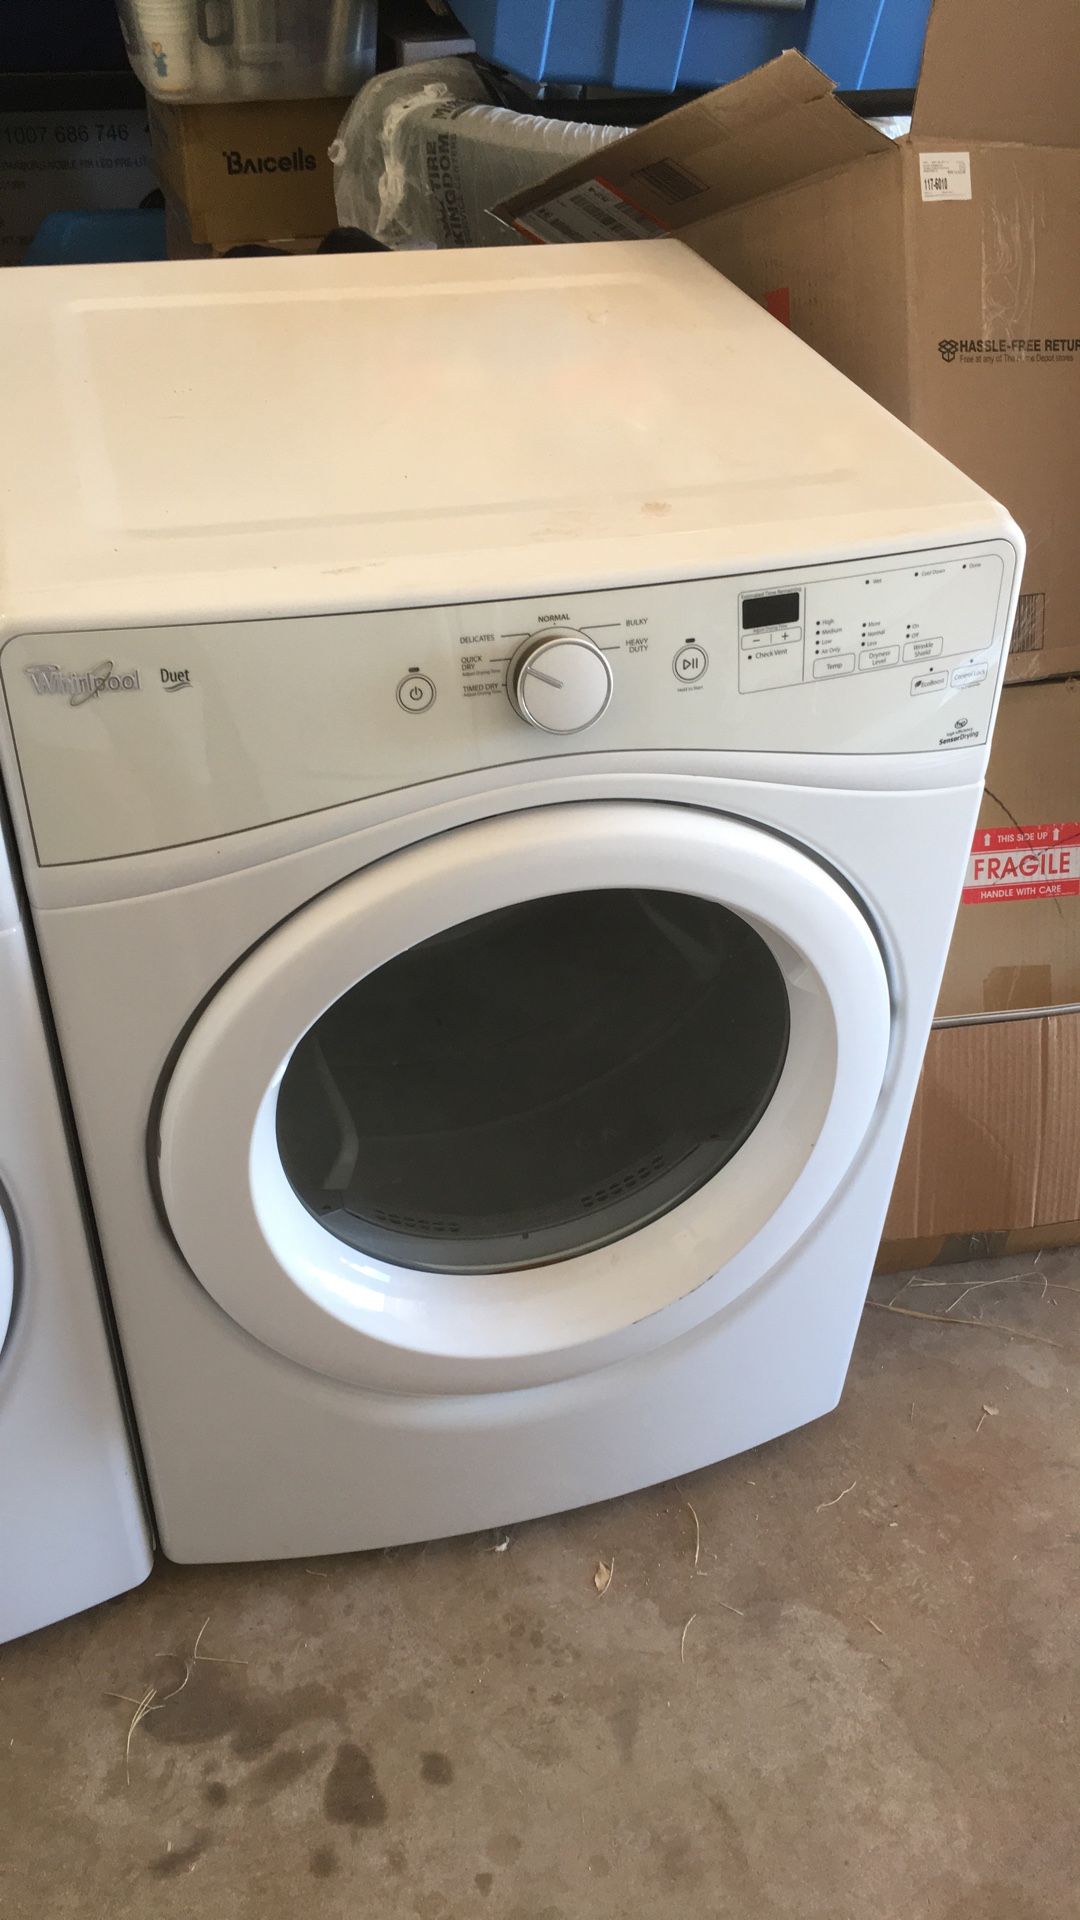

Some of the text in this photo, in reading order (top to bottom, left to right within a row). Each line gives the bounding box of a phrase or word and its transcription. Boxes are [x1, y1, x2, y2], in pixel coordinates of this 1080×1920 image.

[426, 141, 441, 190] TIRE
[959, 339, 1041, 353] HASSLE-FREE
[537, 613, 570, 623] NORMAL
[625, 617, 648, 627] BULKY
[459, 634, 495, 644] DELICATES
[625, 638, 648, 647] HEAVY
[628, 645, 648, 654] DUTY
[755, 648, 788, 660] Check Vent
[460, 655, 483, 664] QUICK
[461, 663, 475, 671] DRY
[826, 662, 843, 671] Temp
[25, 661, 191, 702] Whirlpool Duet
[462, 683, 499, 693] TIMED DRY
[939, 731, 979, 746] SensorDrying
[997, 831, 1048, 844] THIS SIDE UP
[974, 852, 1071, 881] FRAGILE
[980, 888, 1013, 900] HANDLE
[1016, 886, 1036, 896] WITH
[1039, 884, 1062, 895] CARE
